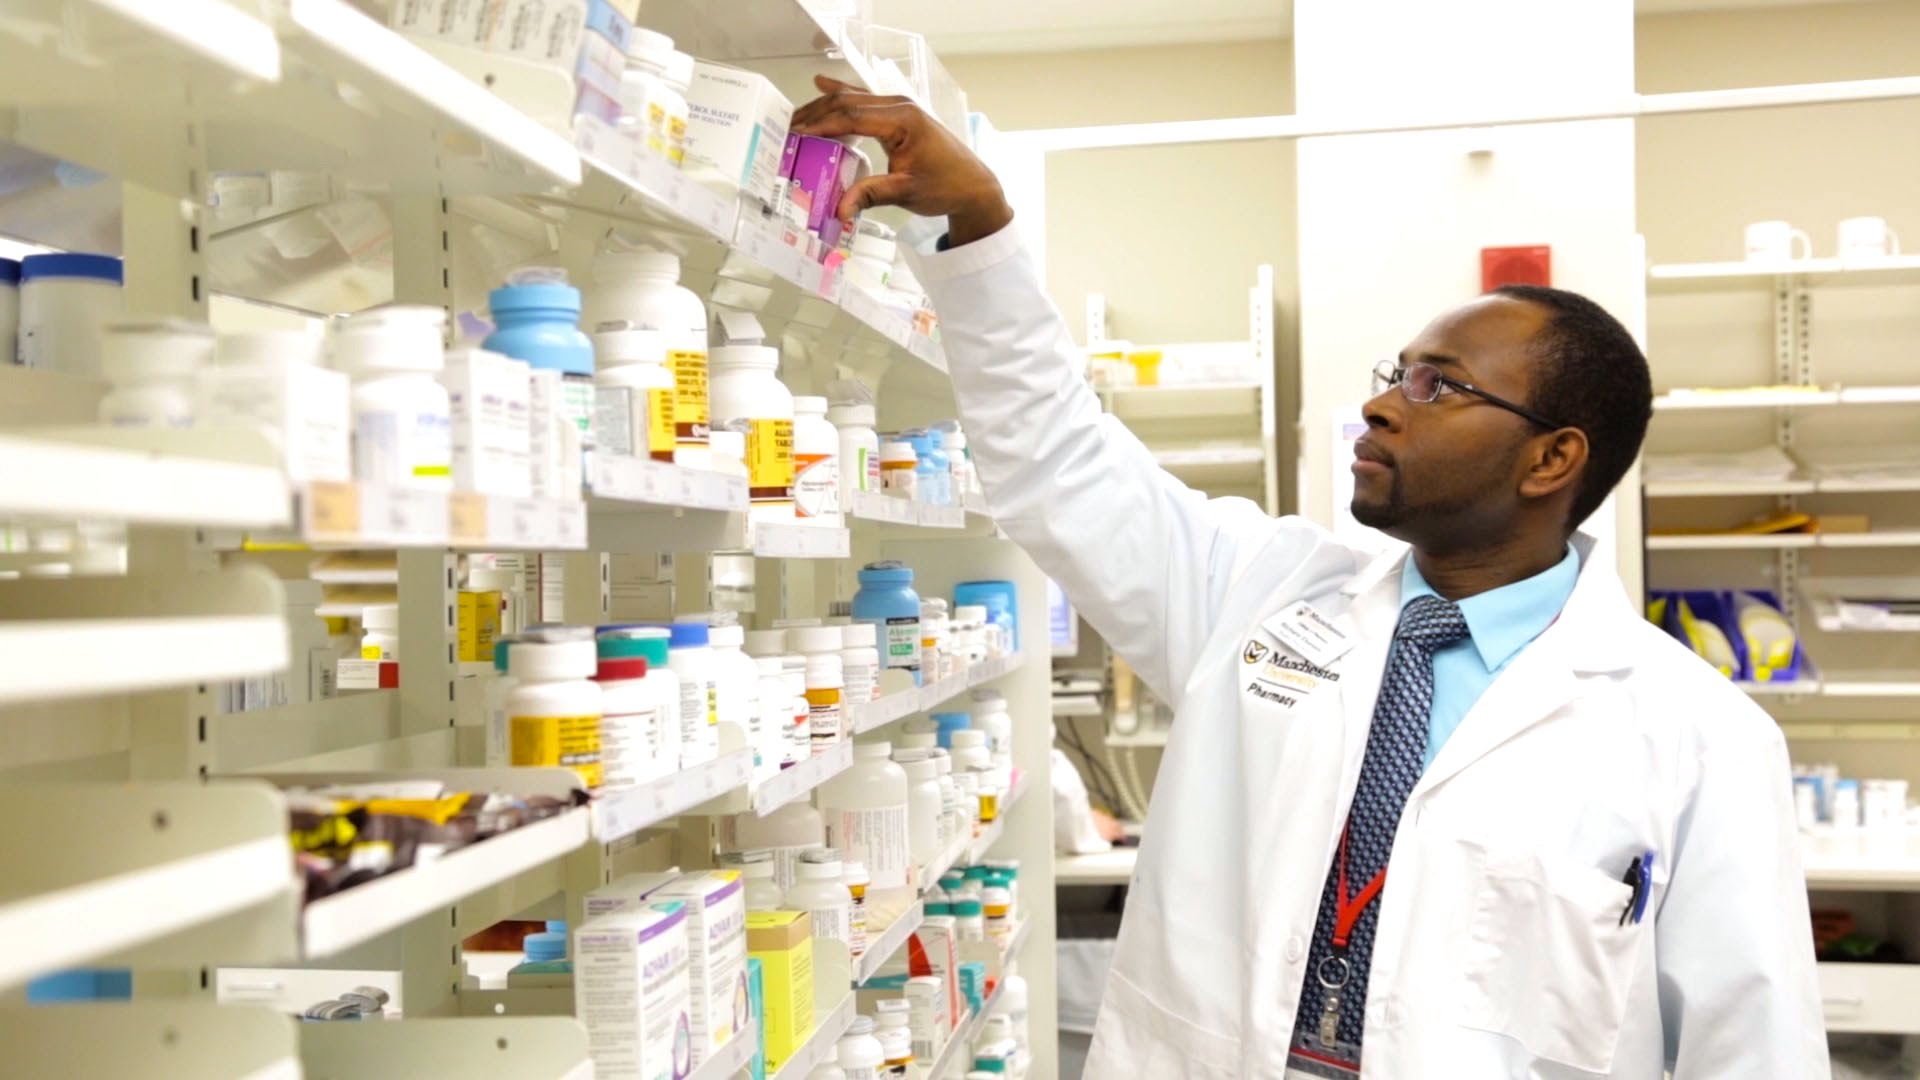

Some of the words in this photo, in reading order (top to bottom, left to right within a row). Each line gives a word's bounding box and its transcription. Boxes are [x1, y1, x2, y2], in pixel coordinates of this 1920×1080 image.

[1264, 665, 1319, 689] University
[1268, 651, 1340, 682] Manchester
[1246, 682, 1297, 709] Pharmacy
